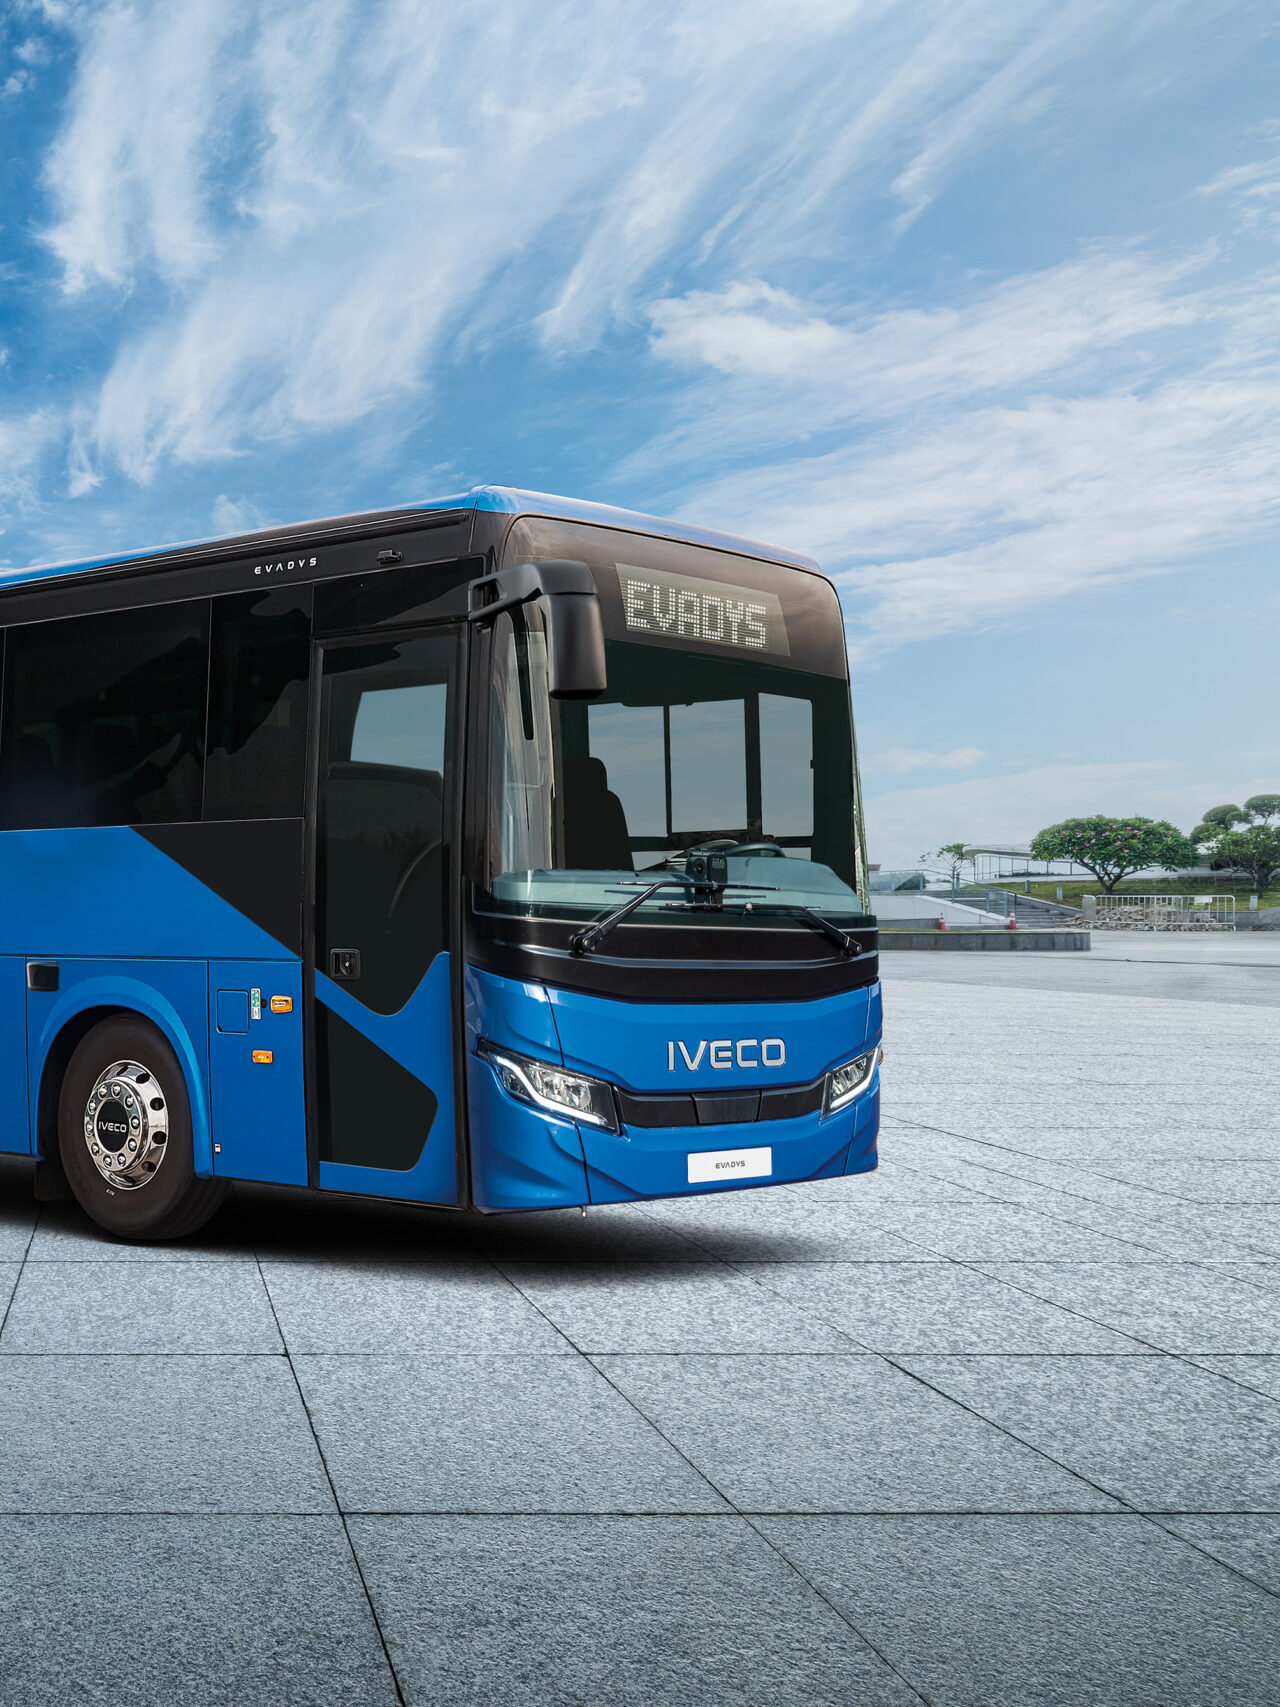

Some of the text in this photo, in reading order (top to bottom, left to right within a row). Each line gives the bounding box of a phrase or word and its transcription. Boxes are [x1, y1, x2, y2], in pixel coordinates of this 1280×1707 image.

[254, 557, 317, 575] EVADYS
[627, 580, 766, 647] EVADYS
[667, 1038, 786, 1072] IVECO
[98, 1121, 127, 1133] IVECO
[715, 1160, 746, 1169] EVADYS
